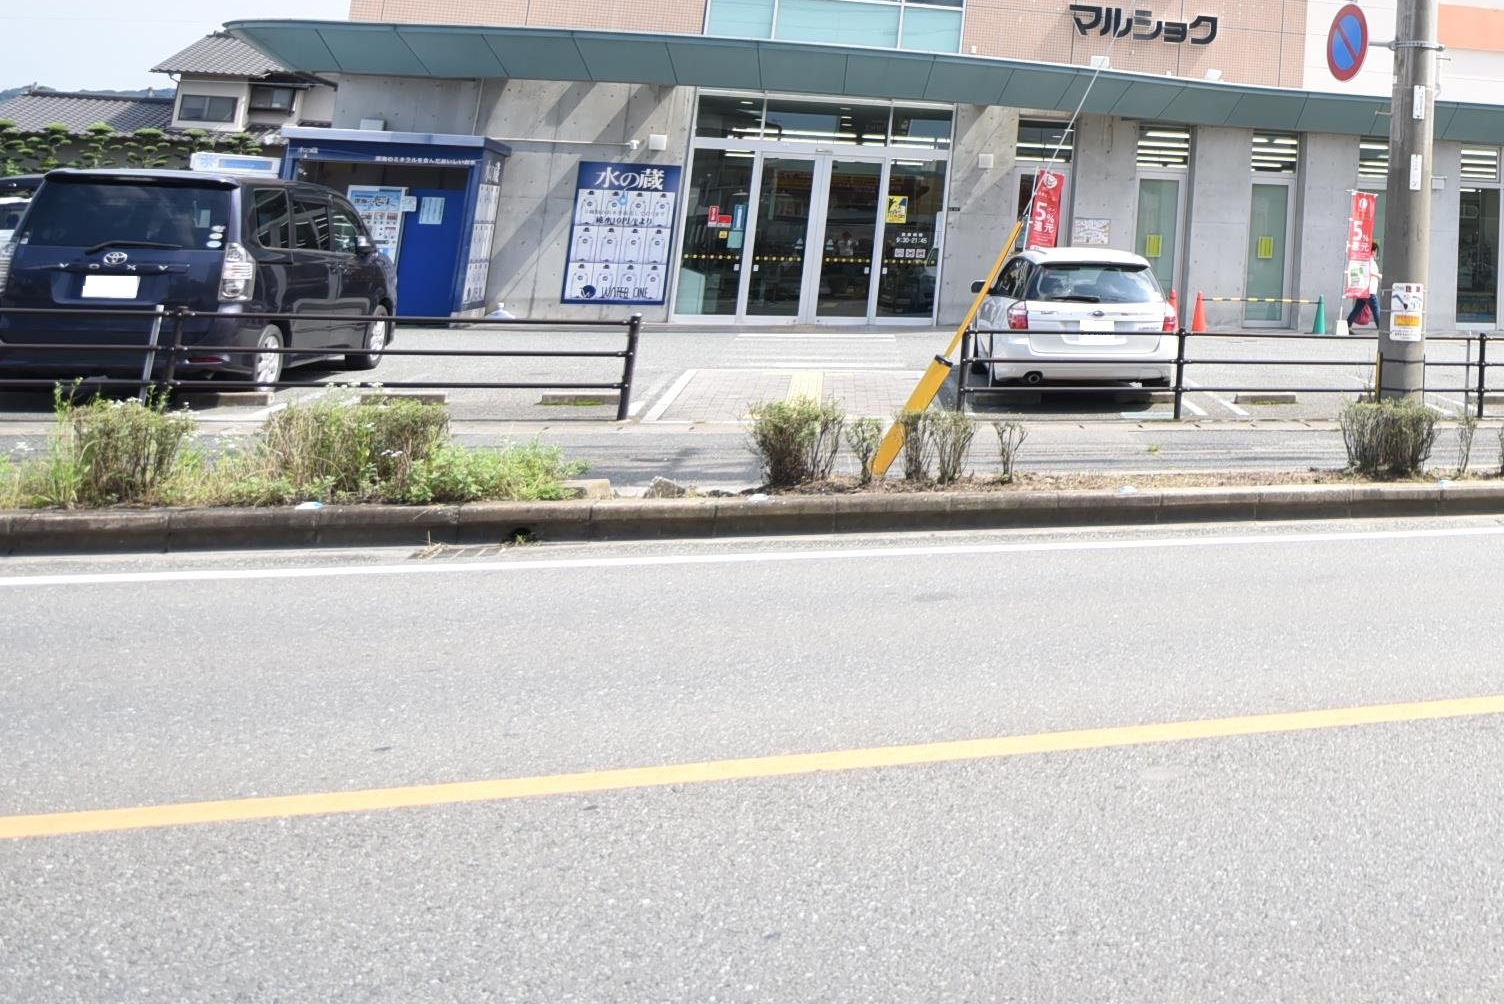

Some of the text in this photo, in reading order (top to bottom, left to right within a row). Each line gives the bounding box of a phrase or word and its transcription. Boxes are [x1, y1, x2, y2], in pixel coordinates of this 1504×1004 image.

[1069, 4, 1218, 45] マルショク
[595, 167, 665, 190] 水の蔵
[59, 262, 168, 271] VOXY
